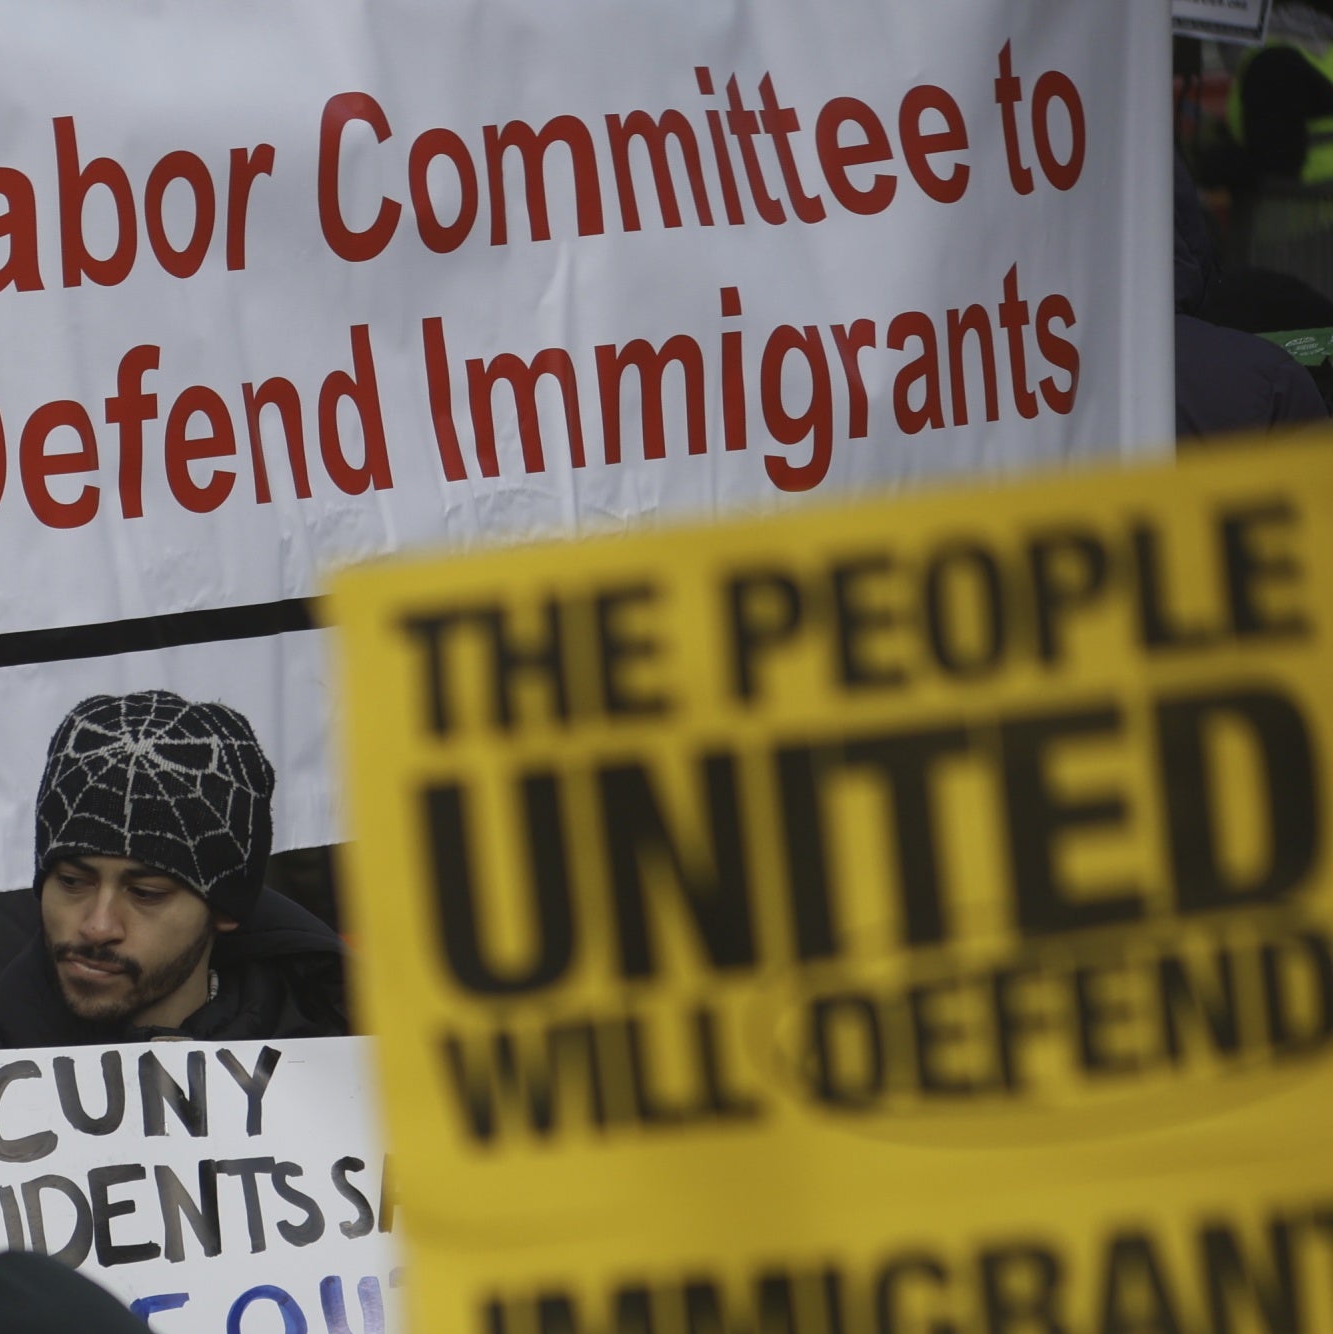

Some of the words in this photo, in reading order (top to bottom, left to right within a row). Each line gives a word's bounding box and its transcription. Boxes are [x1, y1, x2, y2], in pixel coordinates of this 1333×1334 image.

[318, 66, 970, 263] Committee
[993, 37, 1087, 196] to
[421, 260, 1081, 494] Immigrants
[391, 578, 675, 745] THE
[717, 490, 1317, 708] PEOPLE
[410, 675, 1329, 1003] UNITED
[433, 1005, 767, 1150] WILL
[803, 920, 1333, 1116] DEFEND
[330, 1154, 403, 1239] S
